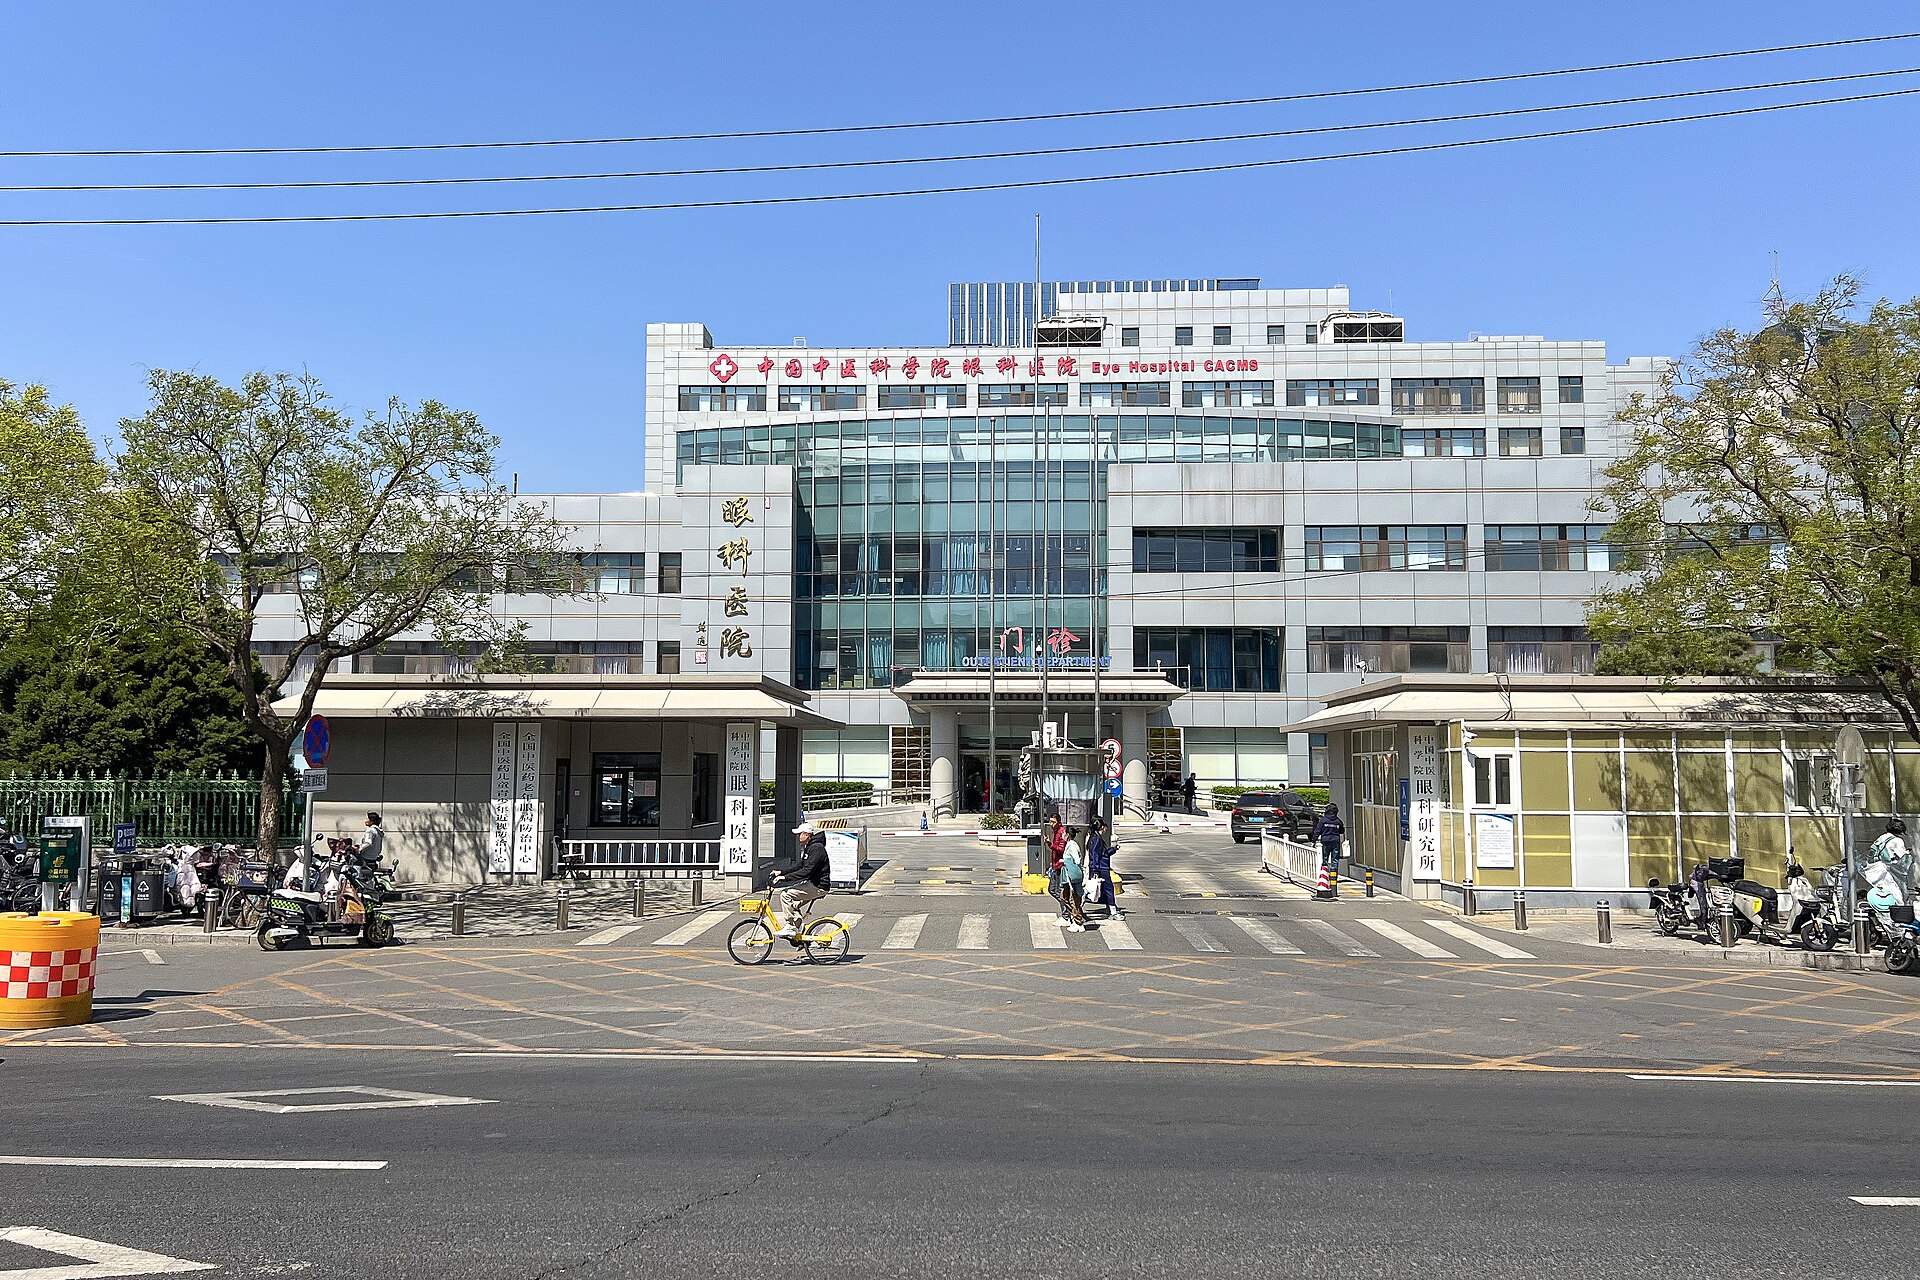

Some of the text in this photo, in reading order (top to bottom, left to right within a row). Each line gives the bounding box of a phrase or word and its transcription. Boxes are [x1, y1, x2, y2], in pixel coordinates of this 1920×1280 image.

[757, 355, 1079, 381] 中国中医科学院眼科医院
[1091, 359, 1259, 376] Eye Hospital CACMS
[716, 496, 755, 660] 眼科医院
[1000, 626, 1081, 654] 门诊
[962, 656, 1112, 667] OUTPATIENT DEPARTMENT
[729, 731, 740, 771] 科学院
[740, 731, 750, 771] 中国中医
[1413, 734, 1424, 776] 科学院
[1424, 734, 1436, 776] 中国中医
[519, 732, 536, 863] 全国中医药老年眼病防治中心
[729, 774, 748, 865] 眼科医院
[1416, 779, 1436, 872] 眼科研究所
